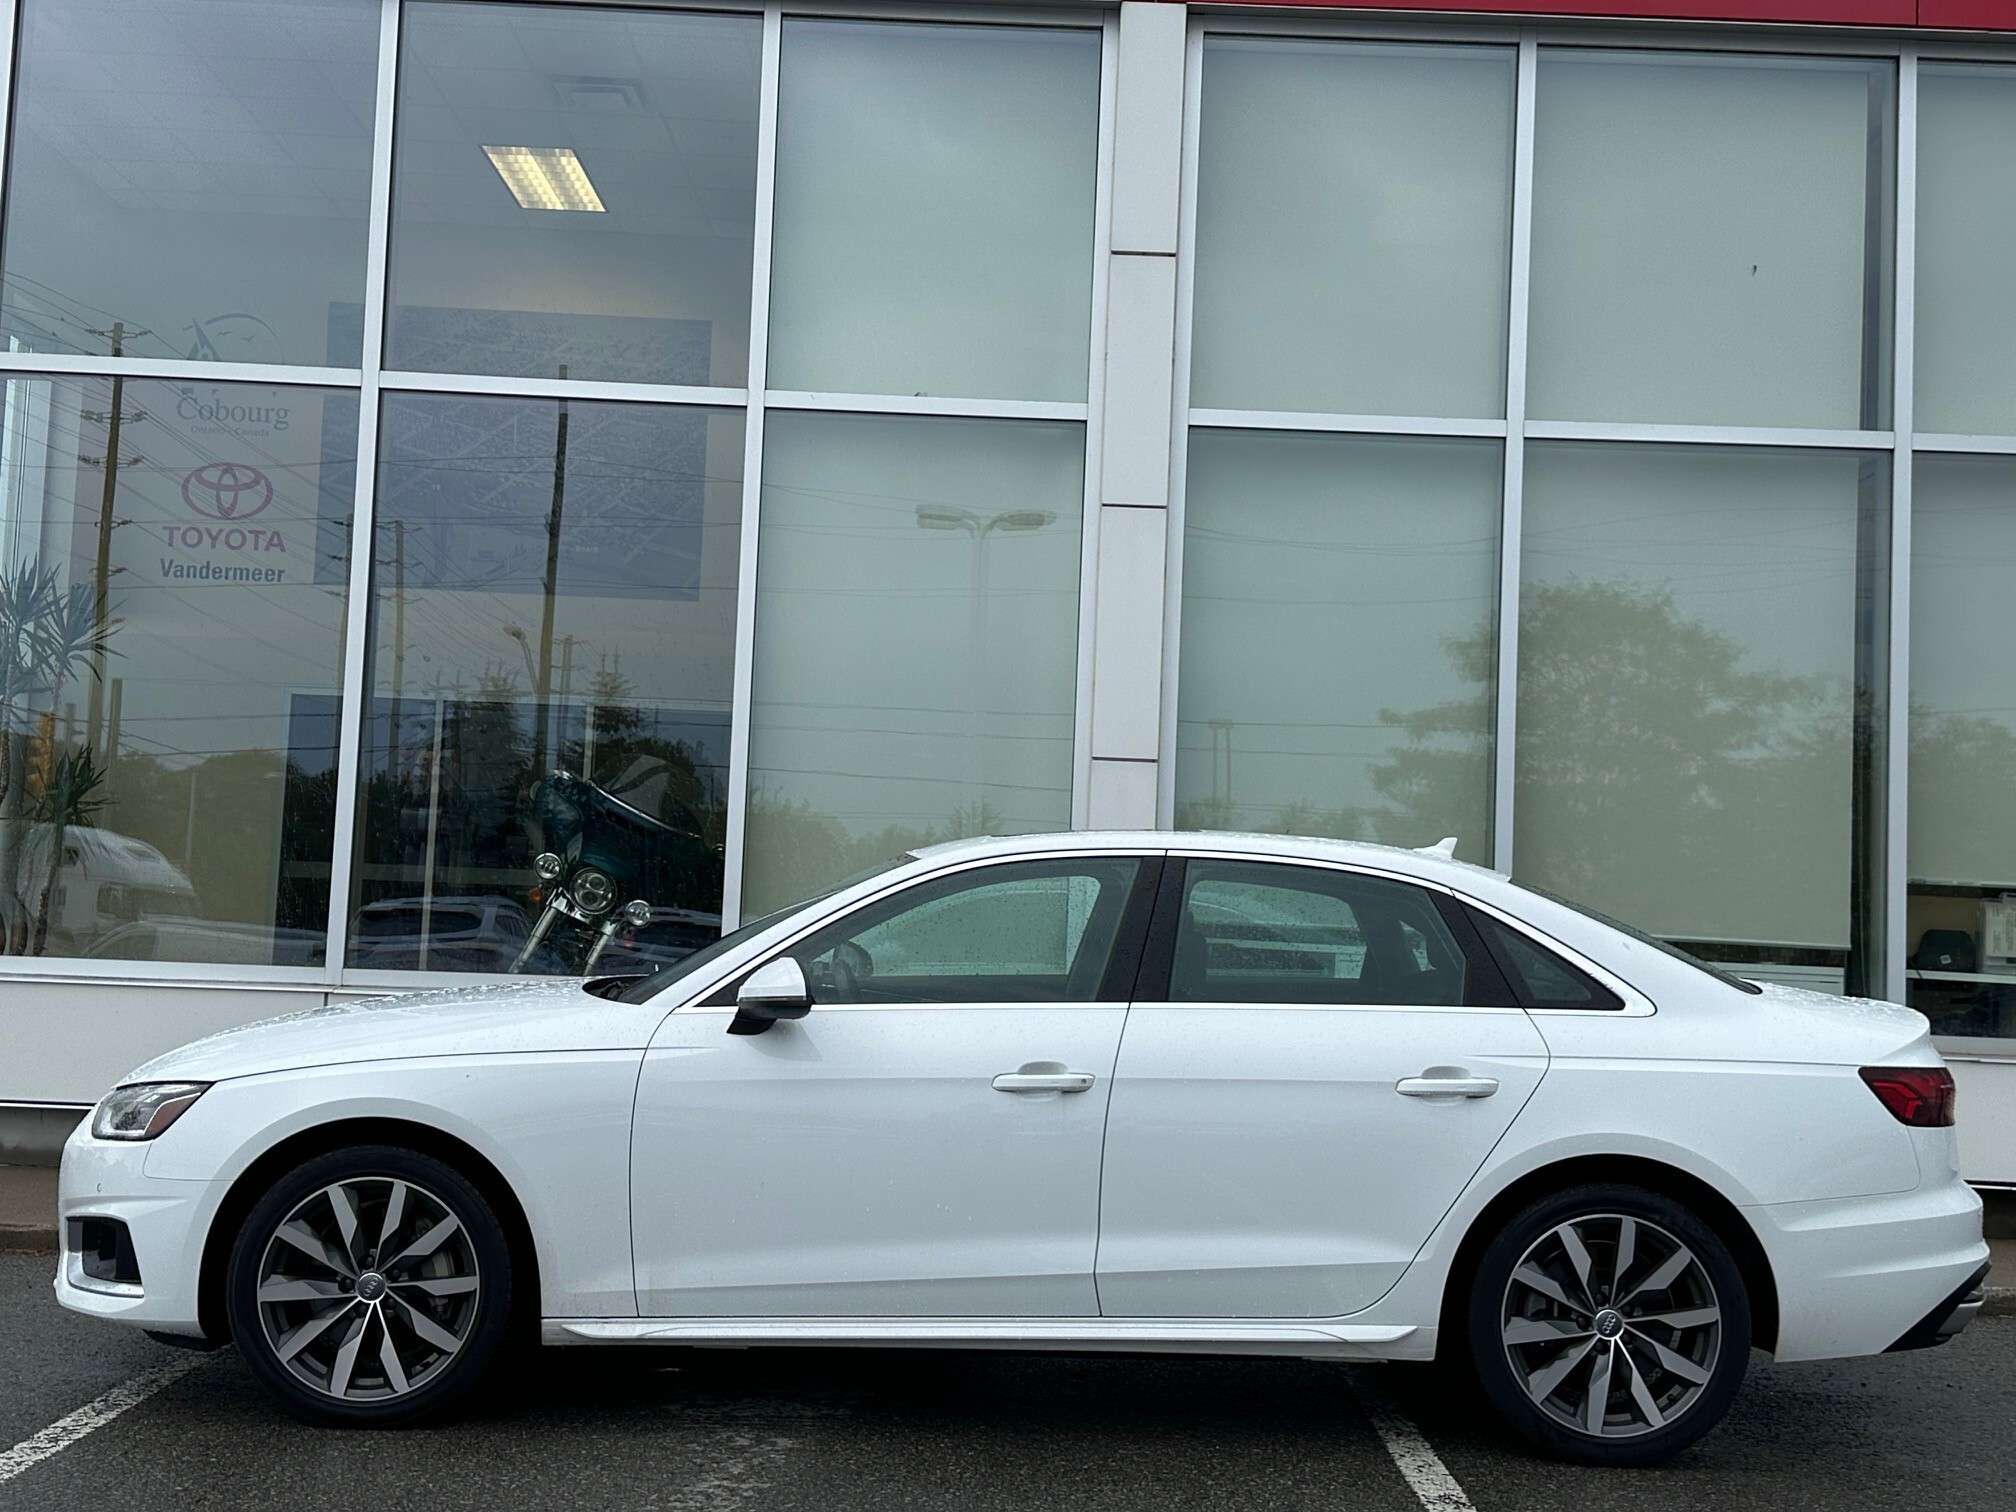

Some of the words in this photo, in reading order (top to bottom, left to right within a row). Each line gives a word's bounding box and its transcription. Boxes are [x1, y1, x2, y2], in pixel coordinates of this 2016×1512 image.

[177, 399, 289, 431] Cobourg
[162, 526, 286, 552] TOYOTA
[160, 558, 286, 582] Vandermeer
